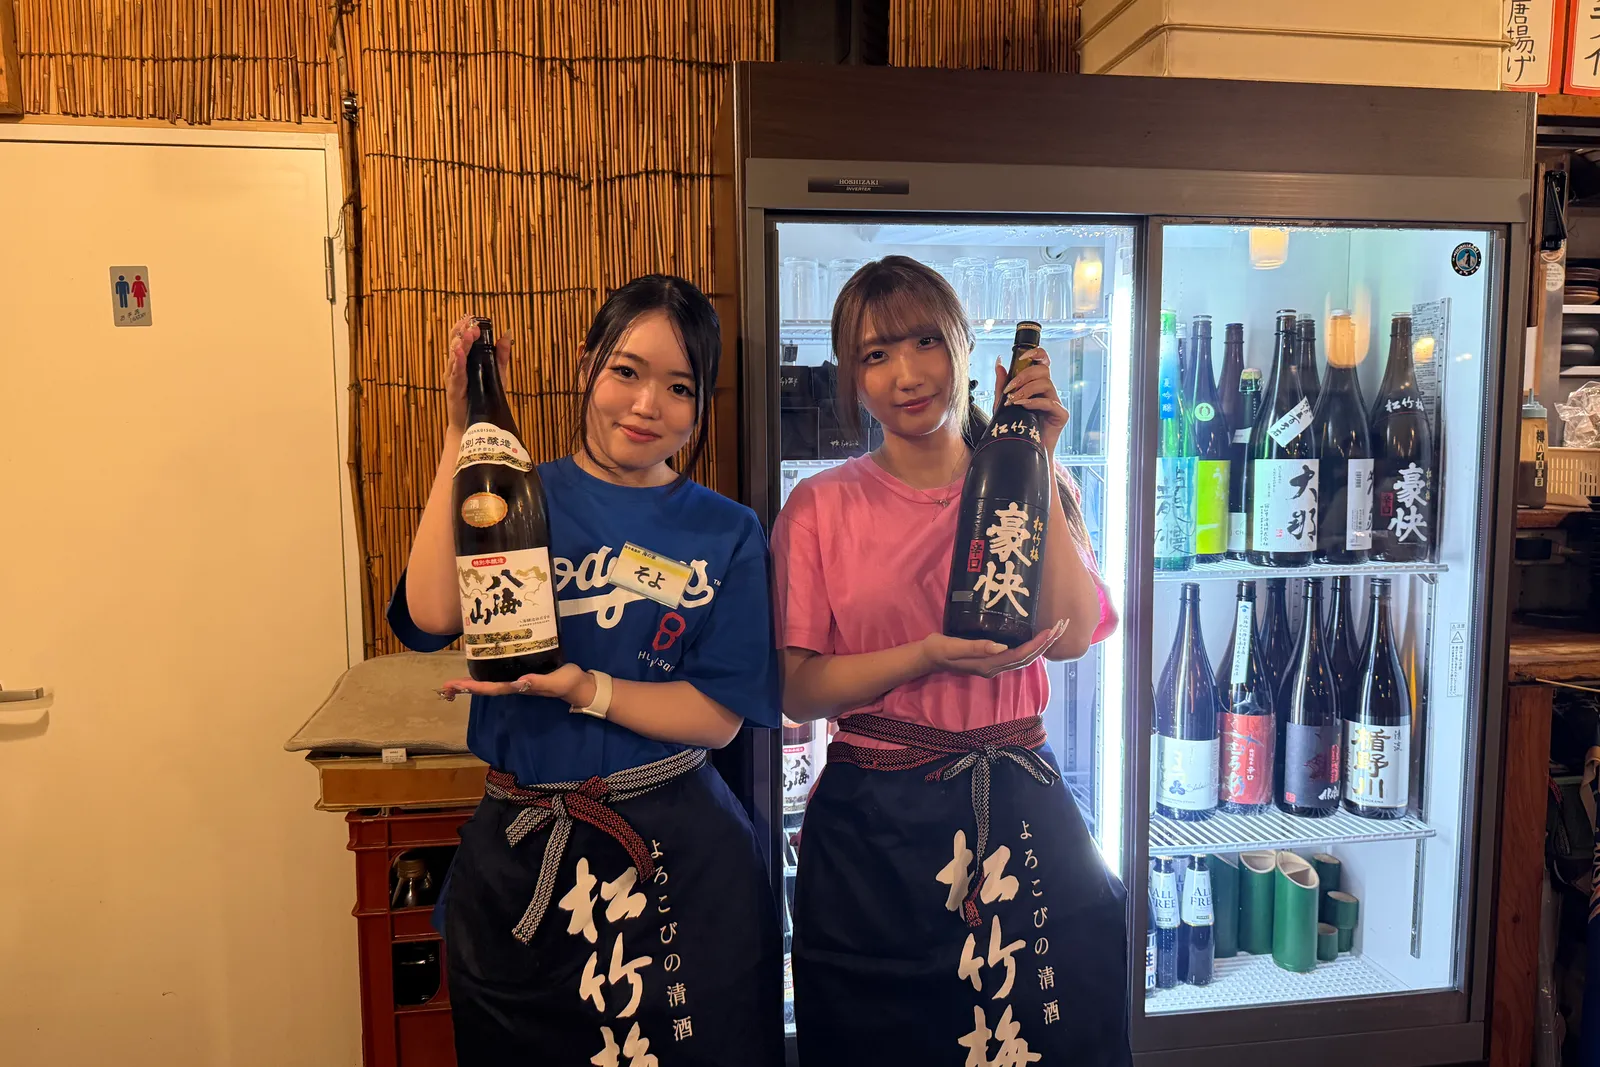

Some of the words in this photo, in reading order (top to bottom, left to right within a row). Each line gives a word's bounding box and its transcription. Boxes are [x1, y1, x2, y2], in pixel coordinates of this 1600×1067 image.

[990, 419, 1042, 444] 松竹梅
[1387, 461, 1429, 543] 豪快
[969, 541, 983, 570] 辛口
[973, 501, 1033, 618] 豪快
[1029, 515, 1044, 562] 松竹梅
[470, 569, 524, 625] 八海山
[634, 565, 666, 590] そよ
[1152, 888, 1174, 899] ALL
[1190, 896, 1213, 906] FRE
[650, 839, 694, 1042] よろこびの清酒
[935, 829, 1043, 1067] 松竹梅
[1020, 820, 1061, 1025] よろこびの清酒
